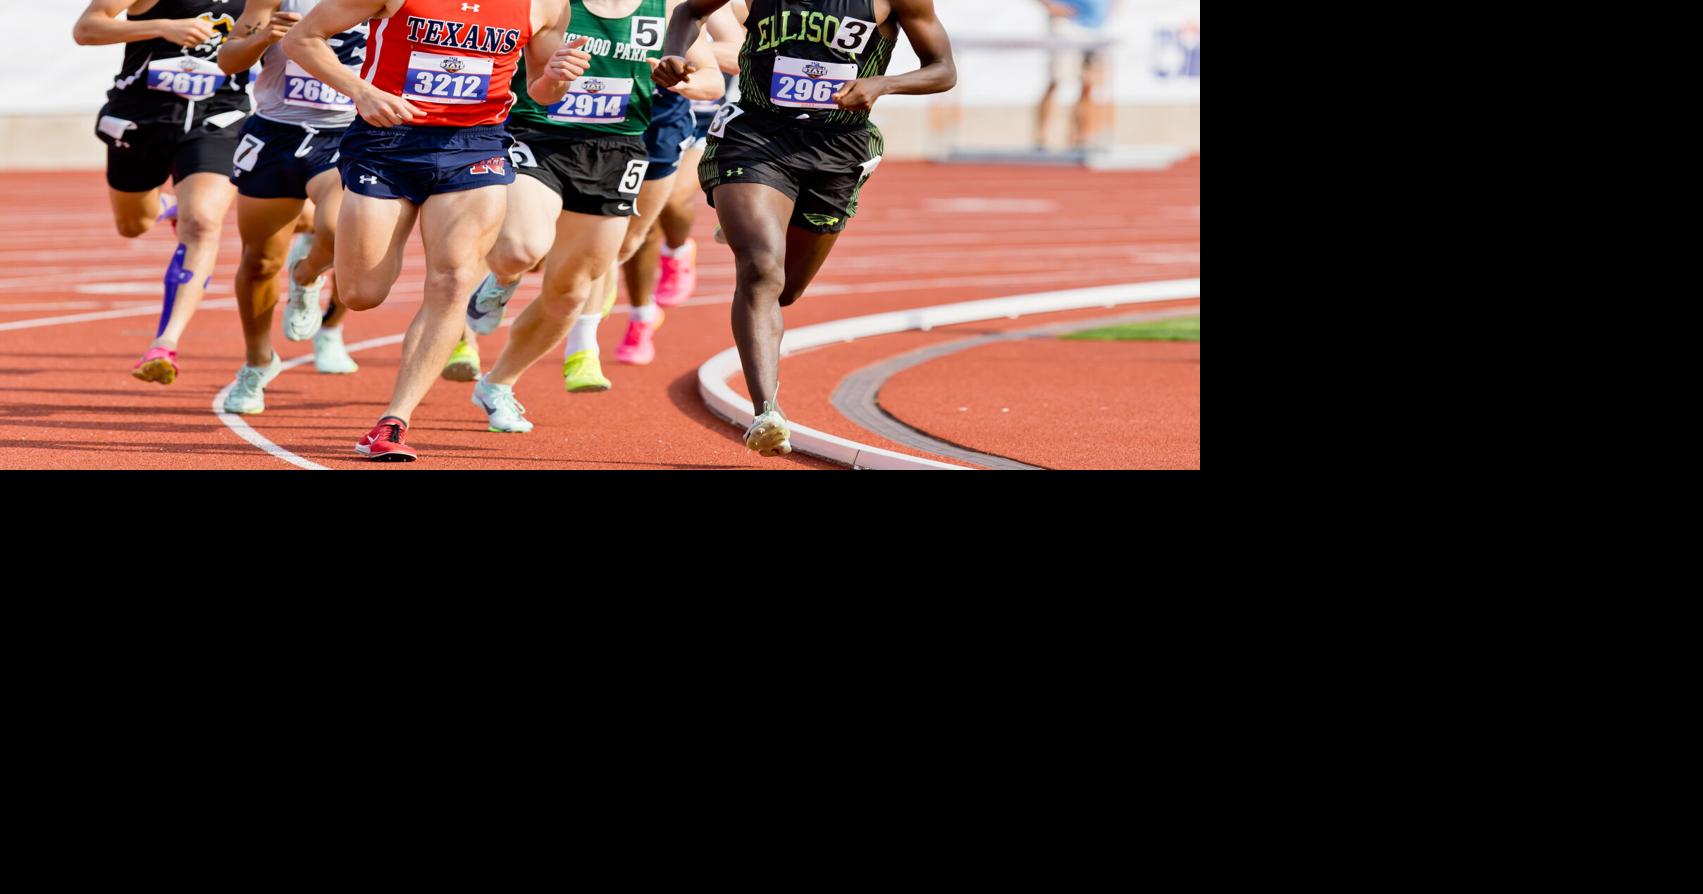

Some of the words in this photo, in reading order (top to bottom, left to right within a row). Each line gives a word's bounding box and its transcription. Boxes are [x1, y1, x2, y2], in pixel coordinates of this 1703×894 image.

[406, 15, 520, 54] TEXANS
[635, 18, 659, 48] 5
[756, 10, 849, 54] ELLISO
[837, 21, 868, 50] 3
[156, 71, 216, 95] 2611
[414, 72, 482, 98] 3212
[560, 94, 621, 116] 2914
[710, 105, 736, 133] 3
[237, 138, 259, 163] 7
[624, 162, 644, 190] 5
